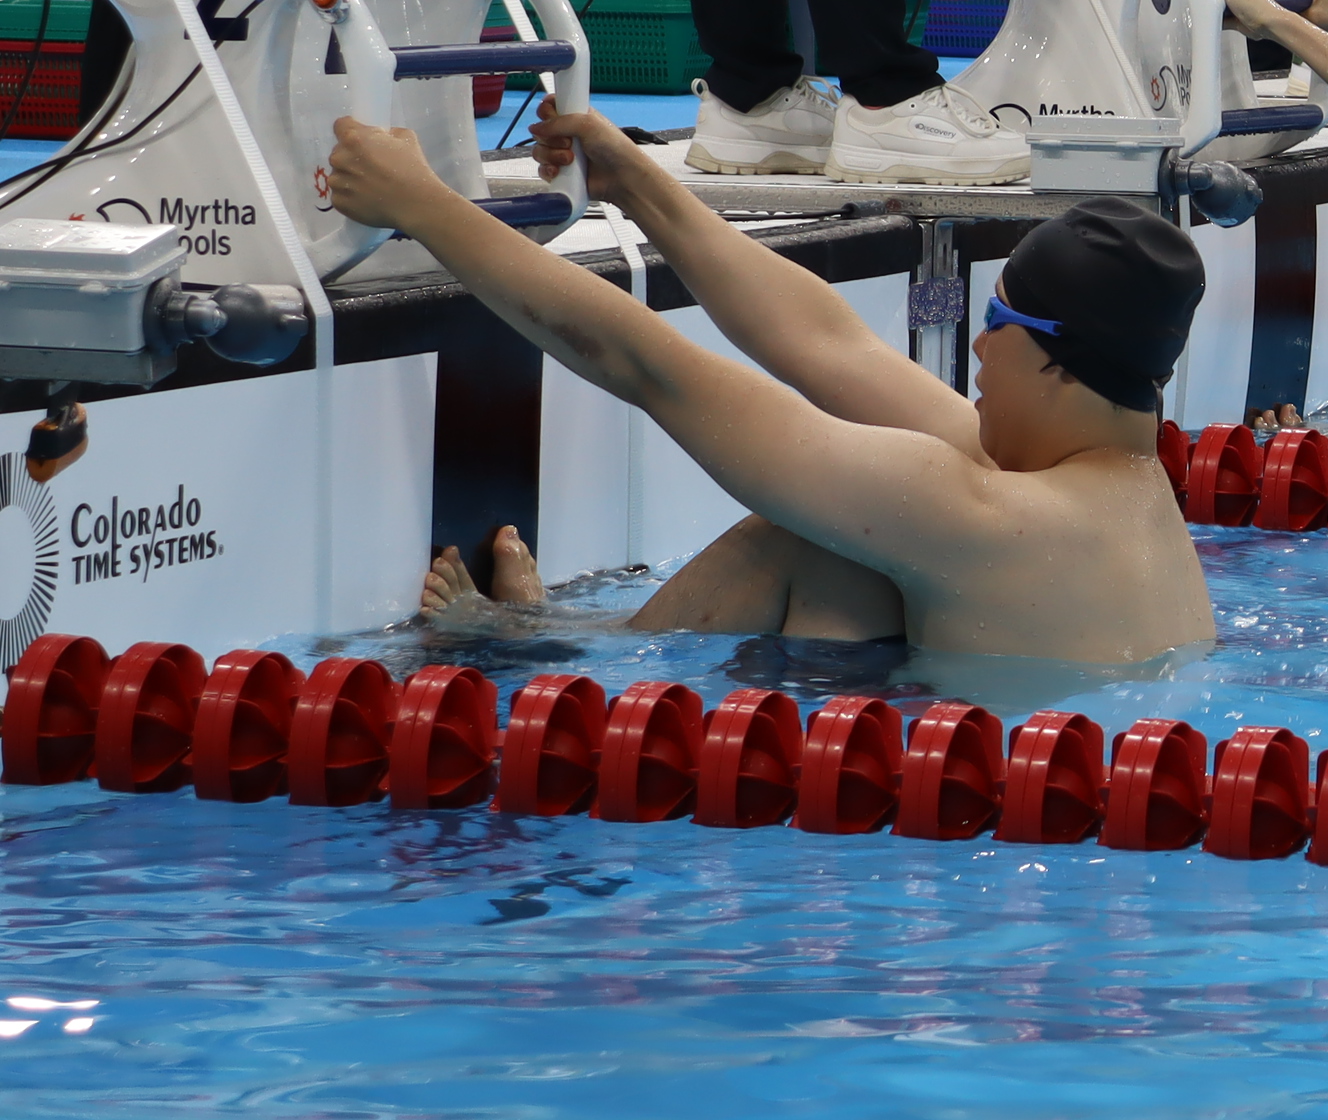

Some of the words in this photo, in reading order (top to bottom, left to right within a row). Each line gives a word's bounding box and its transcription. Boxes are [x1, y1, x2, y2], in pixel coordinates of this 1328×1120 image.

[160, 197, 256, 231] Myrtha
[178, 229, 232, 256] ools
[72, 544, 122, 585] TIME
